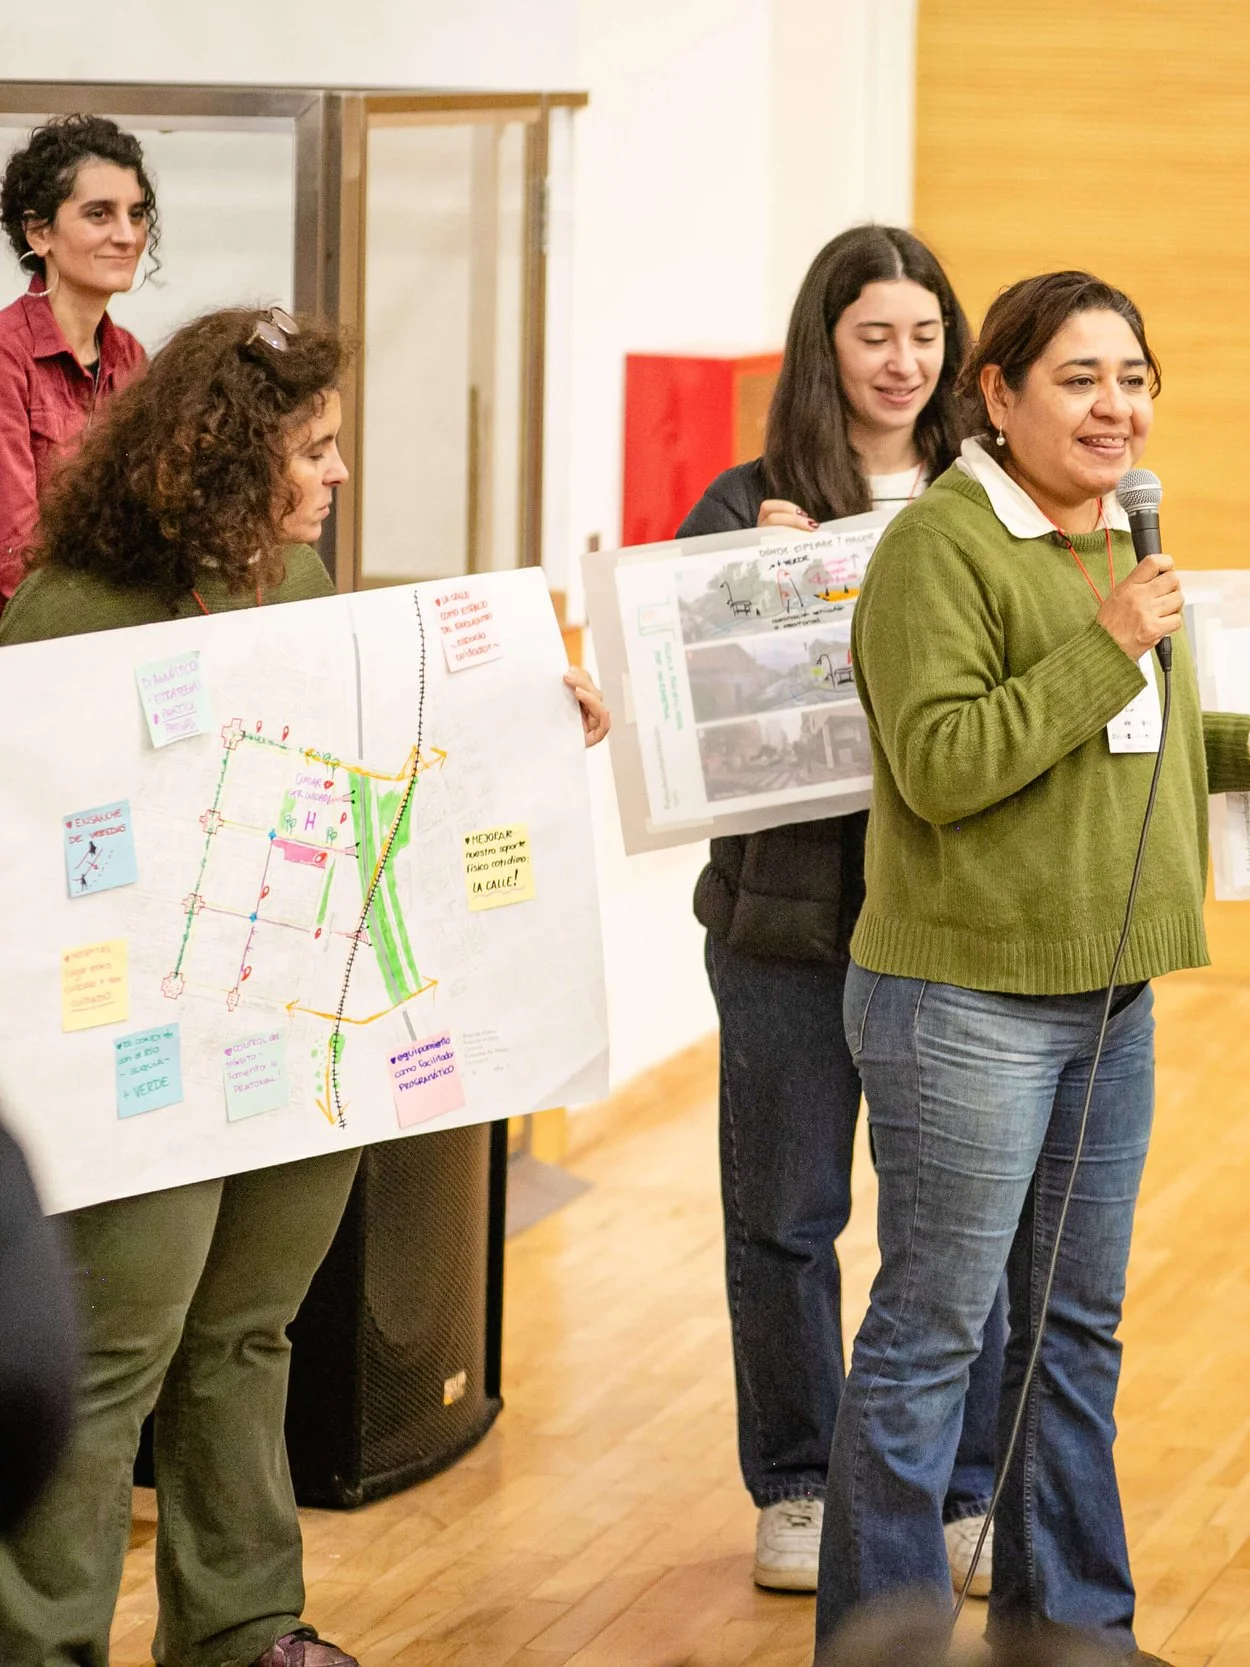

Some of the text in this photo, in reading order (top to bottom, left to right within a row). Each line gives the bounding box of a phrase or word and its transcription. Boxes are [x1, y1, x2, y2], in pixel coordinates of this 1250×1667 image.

[472, 830, 512, 845] MEJORAR
[466, 848, 496, 859] nuestro
[473, 882, 487, 893] LA
[394, 1065, 417, 1078] como
[133, 1076, 169, 1098] VERDE
